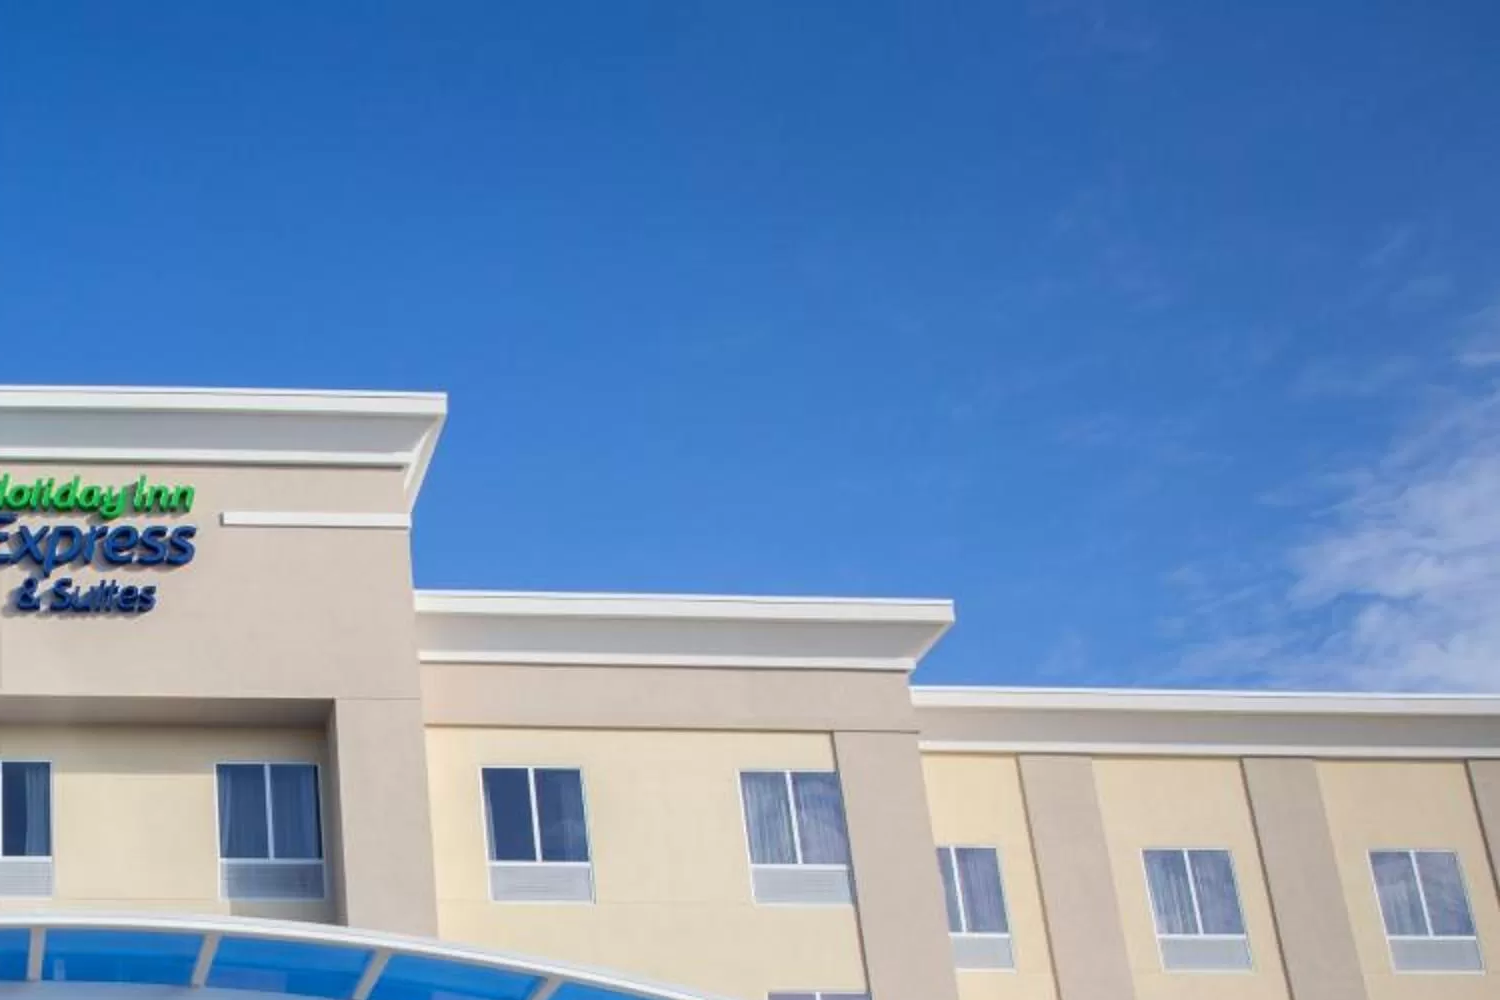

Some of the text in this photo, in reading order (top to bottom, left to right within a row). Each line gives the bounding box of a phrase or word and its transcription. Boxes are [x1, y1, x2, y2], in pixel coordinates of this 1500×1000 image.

[134, 475, 196, 512] Inn
[15, 577, 156, 613] & Suites
